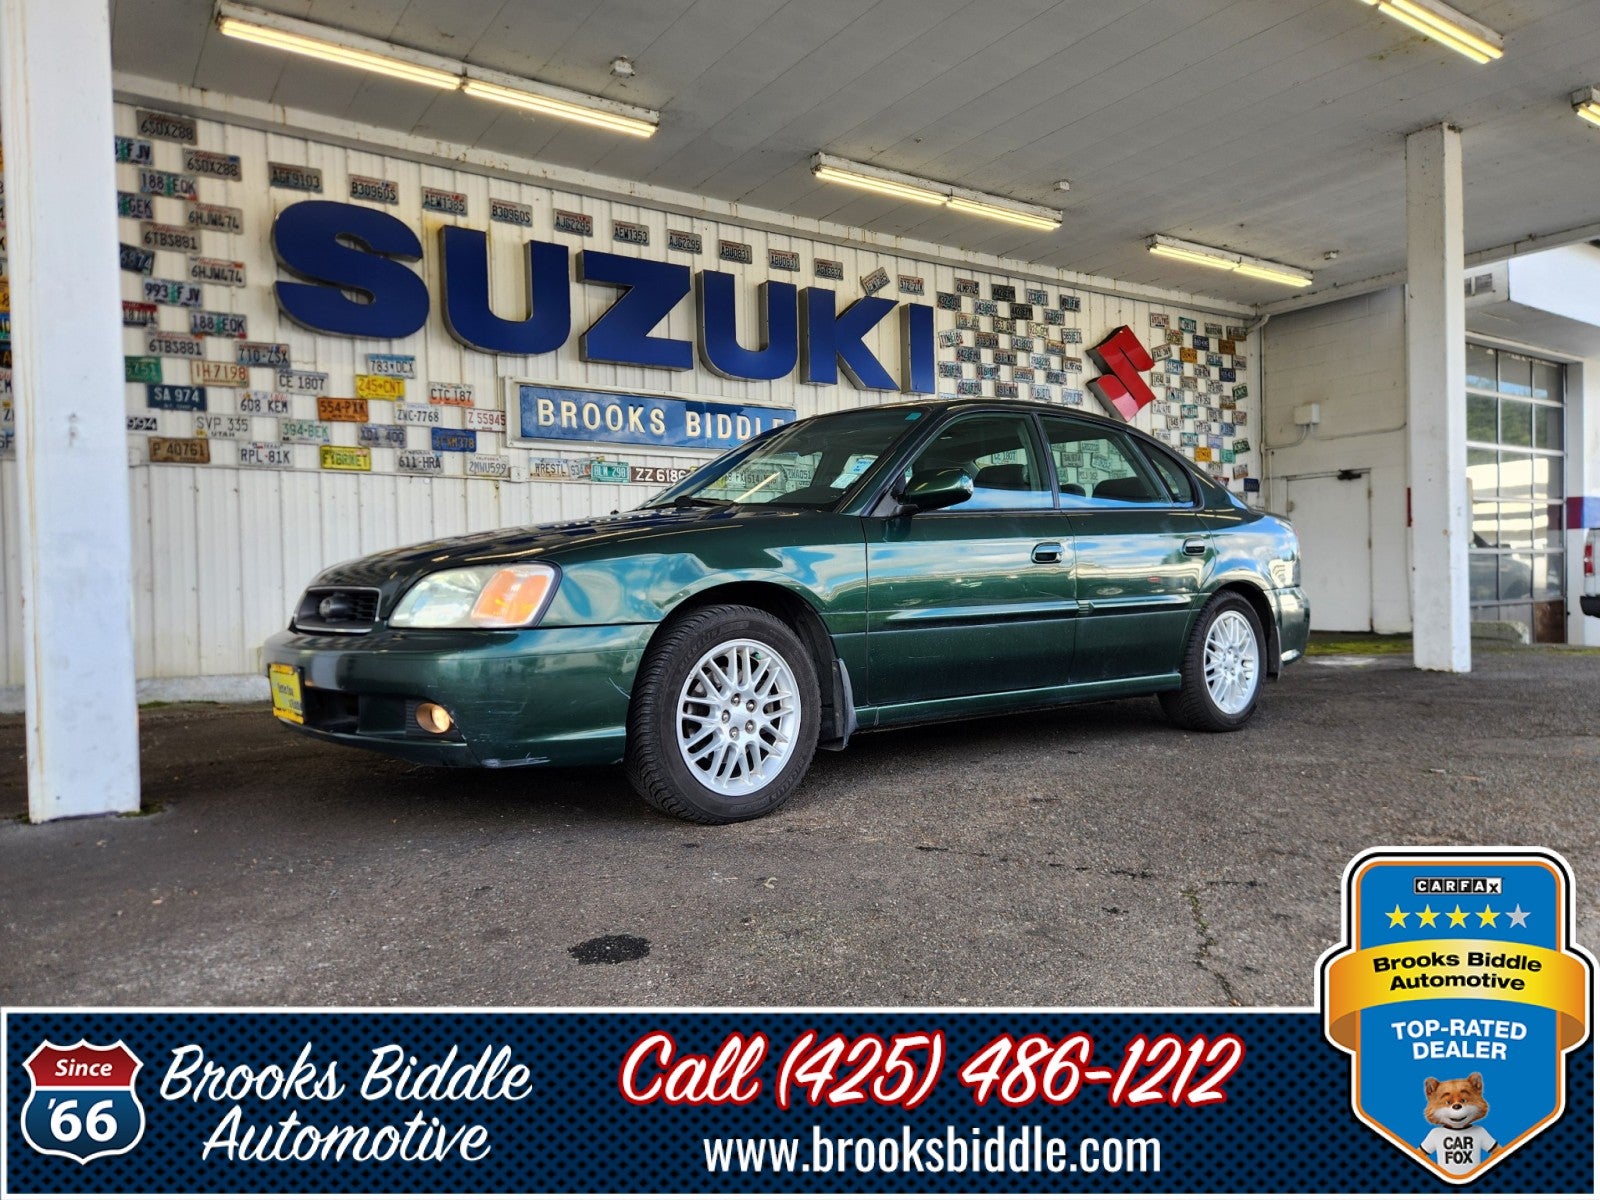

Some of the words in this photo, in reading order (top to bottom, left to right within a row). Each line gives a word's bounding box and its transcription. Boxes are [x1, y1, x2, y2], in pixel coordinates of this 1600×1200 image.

[271, 200, 936, 395] SUZUKI
[192, 315, 214, 329] 188
[279, 375, 293, 388] CE
[298, 376, 324, 390] 1807
[154, 388, 171, 400] SA
[175, 389, 199, 402] 974
[431, 388, 450, 399] CTC
[454, 390, 471, 402] 187
[241, 399, 261, 411] 608
[268, 400, 288, 413] KEM
[477, 412, 506, 426] 55945
[537, 398, 666, 436] BROOKS
[228, 418, 248, 432] 335
[635, 468, 655, 482] ZZ
